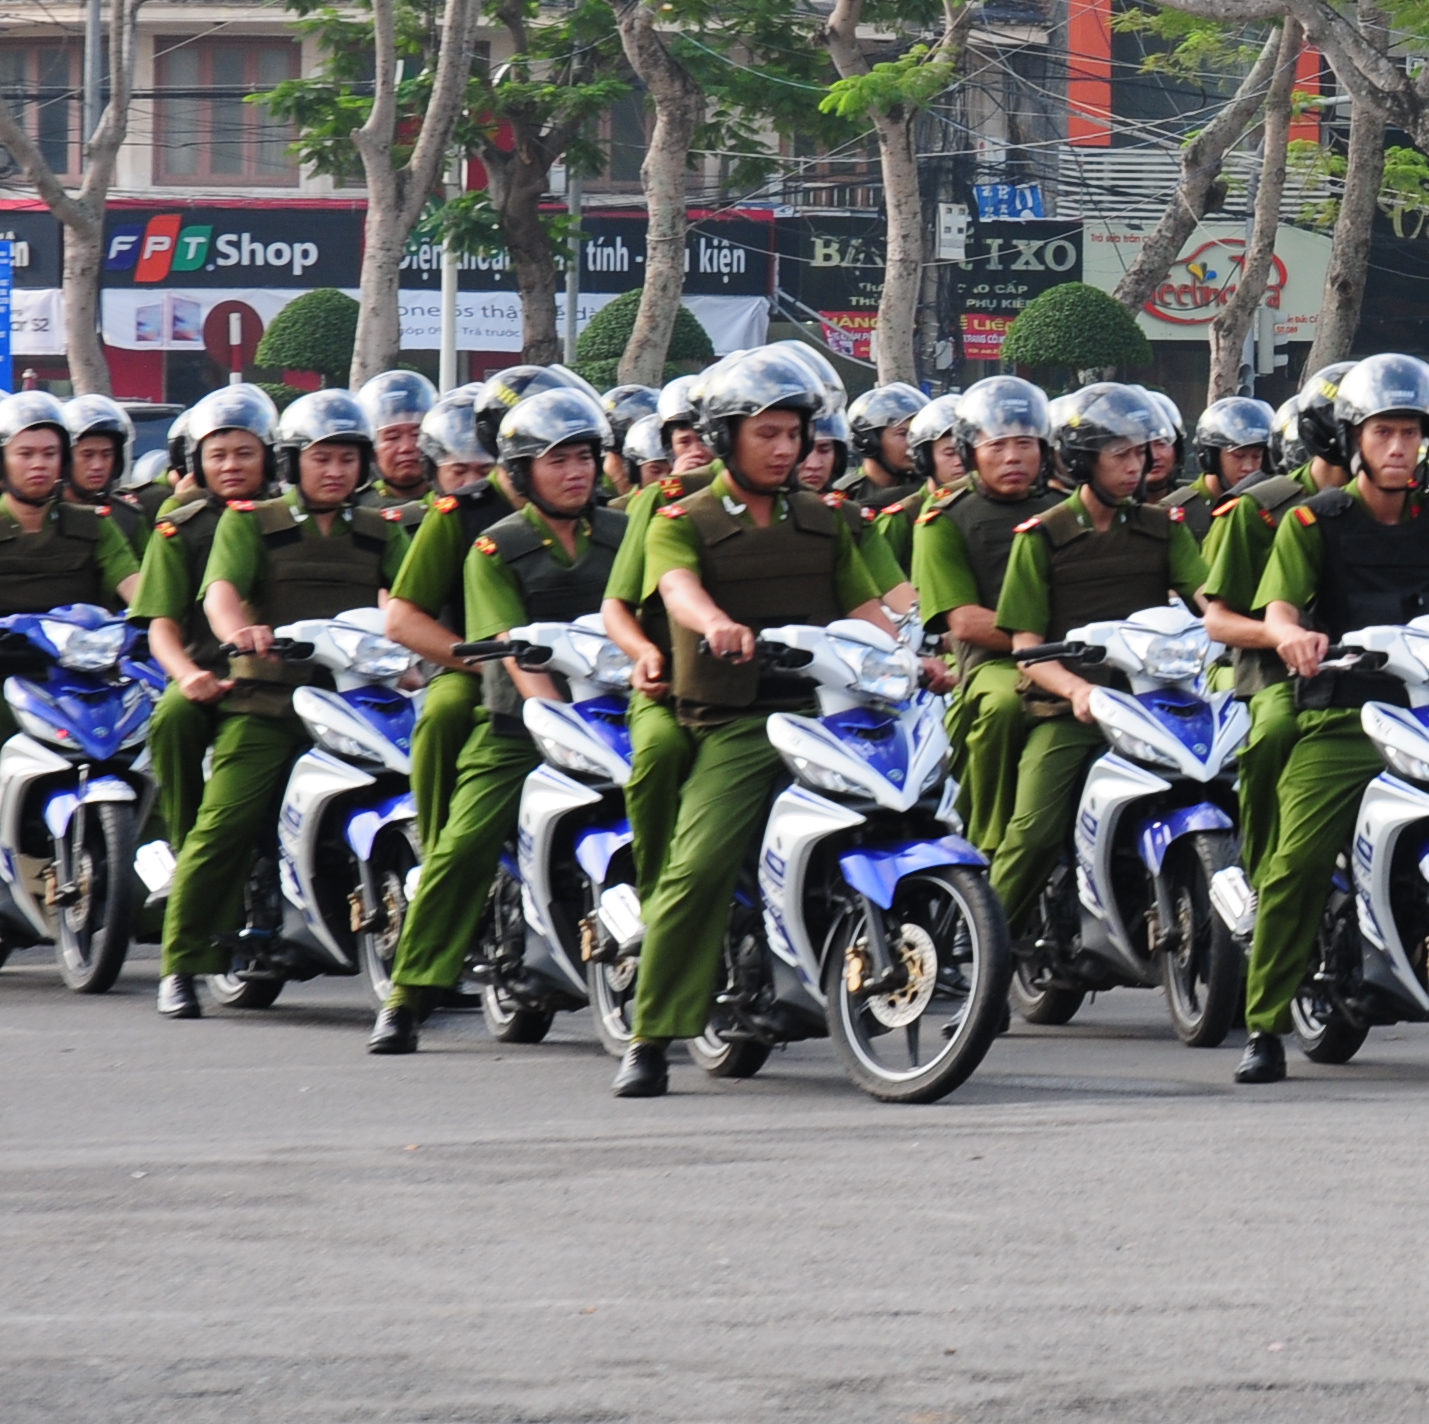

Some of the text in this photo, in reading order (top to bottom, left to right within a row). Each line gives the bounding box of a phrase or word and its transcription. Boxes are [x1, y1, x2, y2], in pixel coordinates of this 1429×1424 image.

[216, 233, 318, 275] Shop
[587, 237, 628, 272] tính
[700, 238, 746, 283] kiện
[480, 304, 521, 323] thậ
